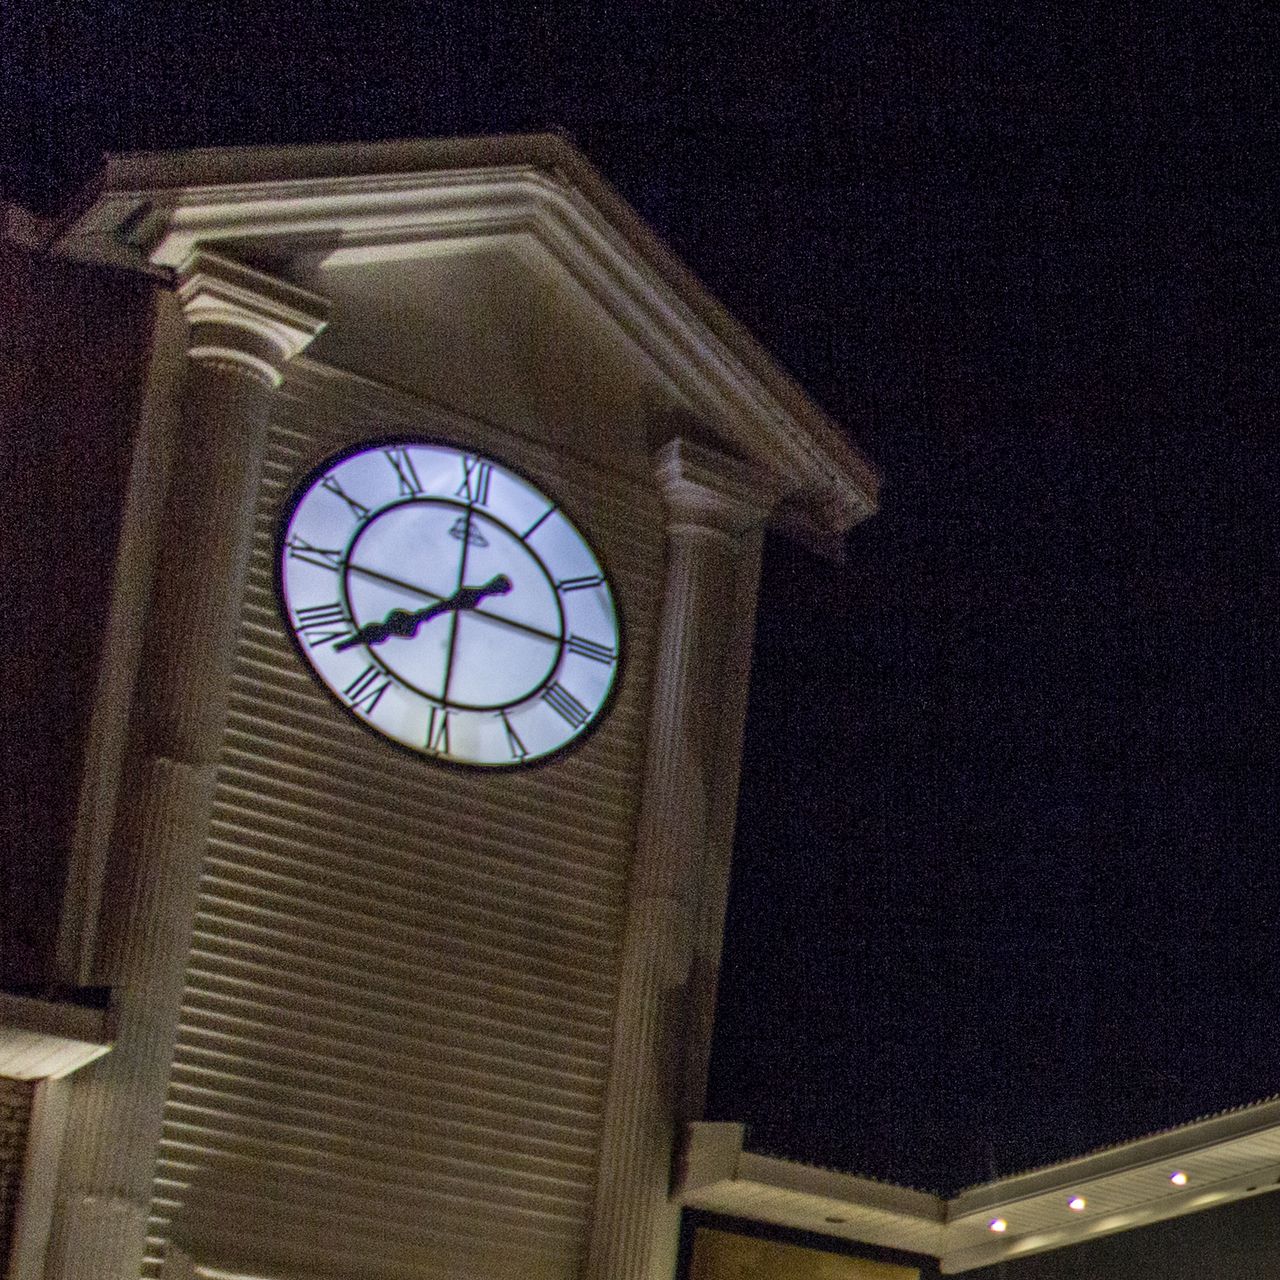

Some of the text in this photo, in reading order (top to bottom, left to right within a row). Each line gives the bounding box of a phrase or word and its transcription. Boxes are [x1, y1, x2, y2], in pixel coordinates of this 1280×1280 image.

[384, 448, 423, 496] XI
[455, 454, 493, 506] XII
[321, 475, 371, 520] X
